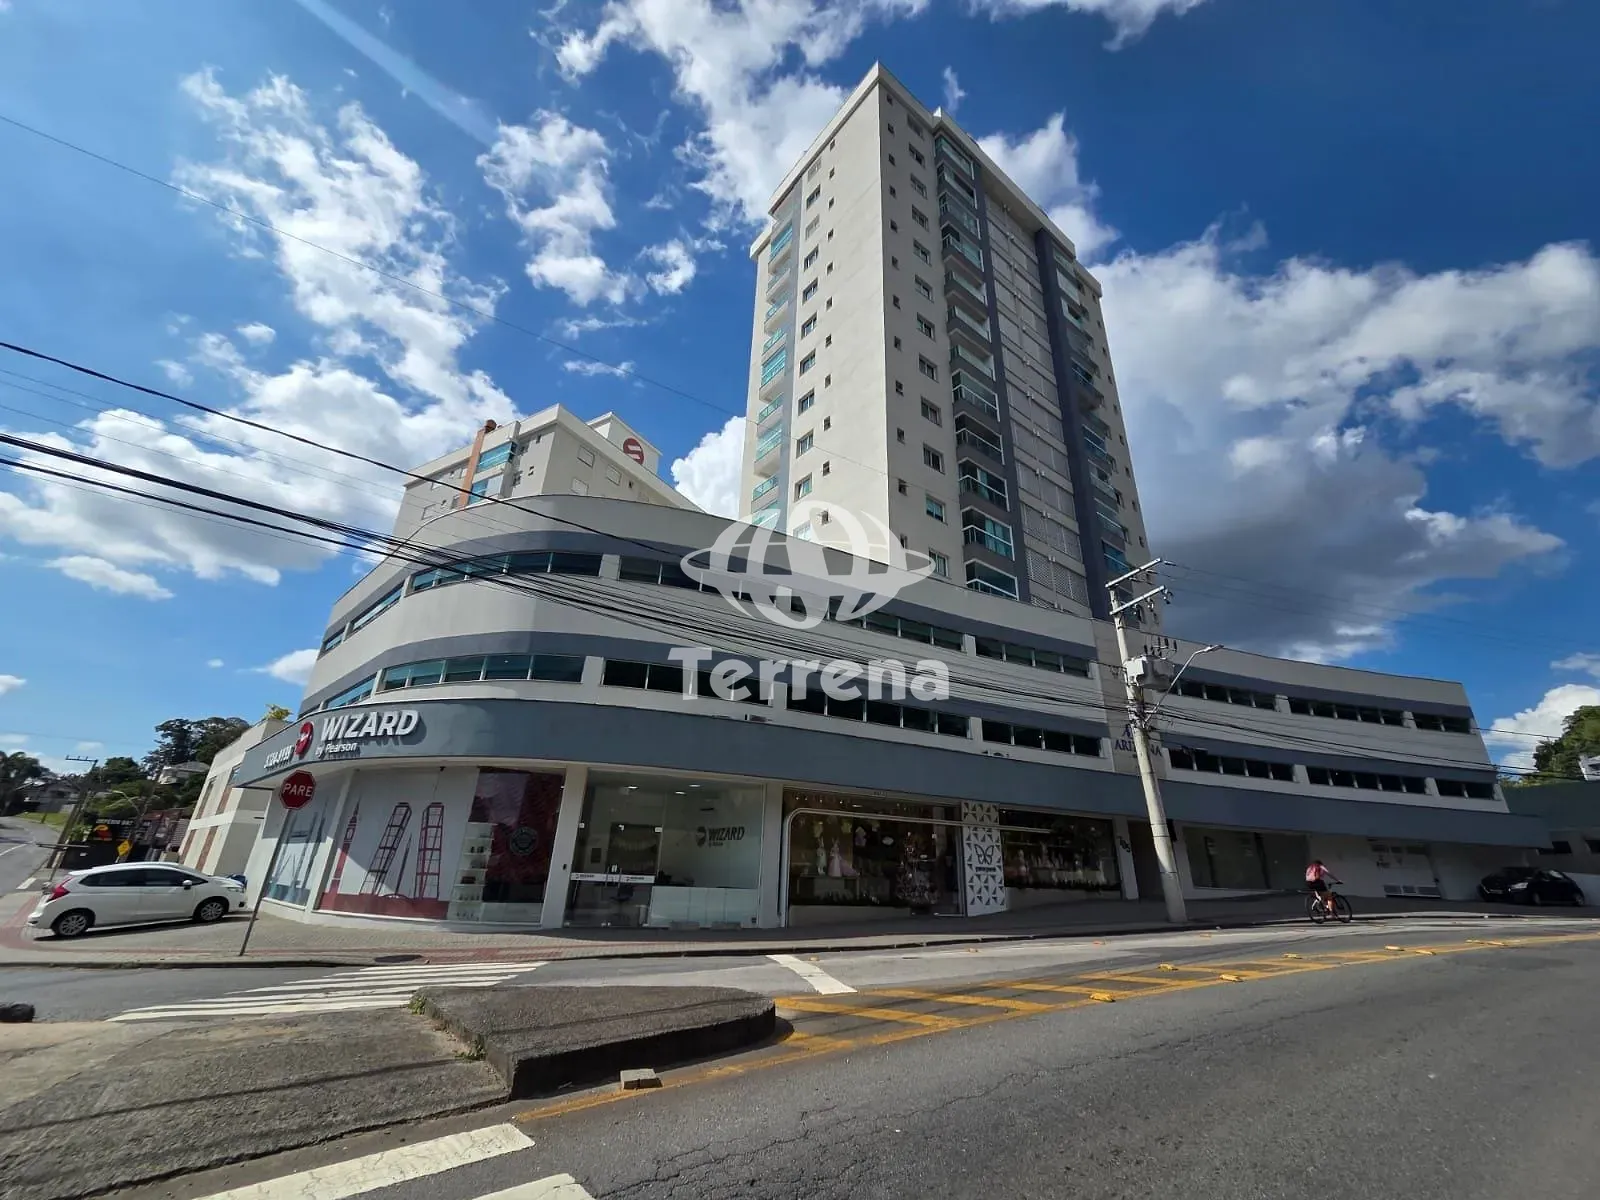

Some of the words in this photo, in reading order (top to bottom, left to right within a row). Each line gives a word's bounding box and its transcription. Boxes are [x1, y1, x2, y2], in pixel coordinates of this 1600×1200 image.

[320, 710, 418, 741] WIZARD
[326, 743, 357, 753] Pearson
[283, 783, 312, 797] PARE
[708, 826, 745, 841] WIZARD
